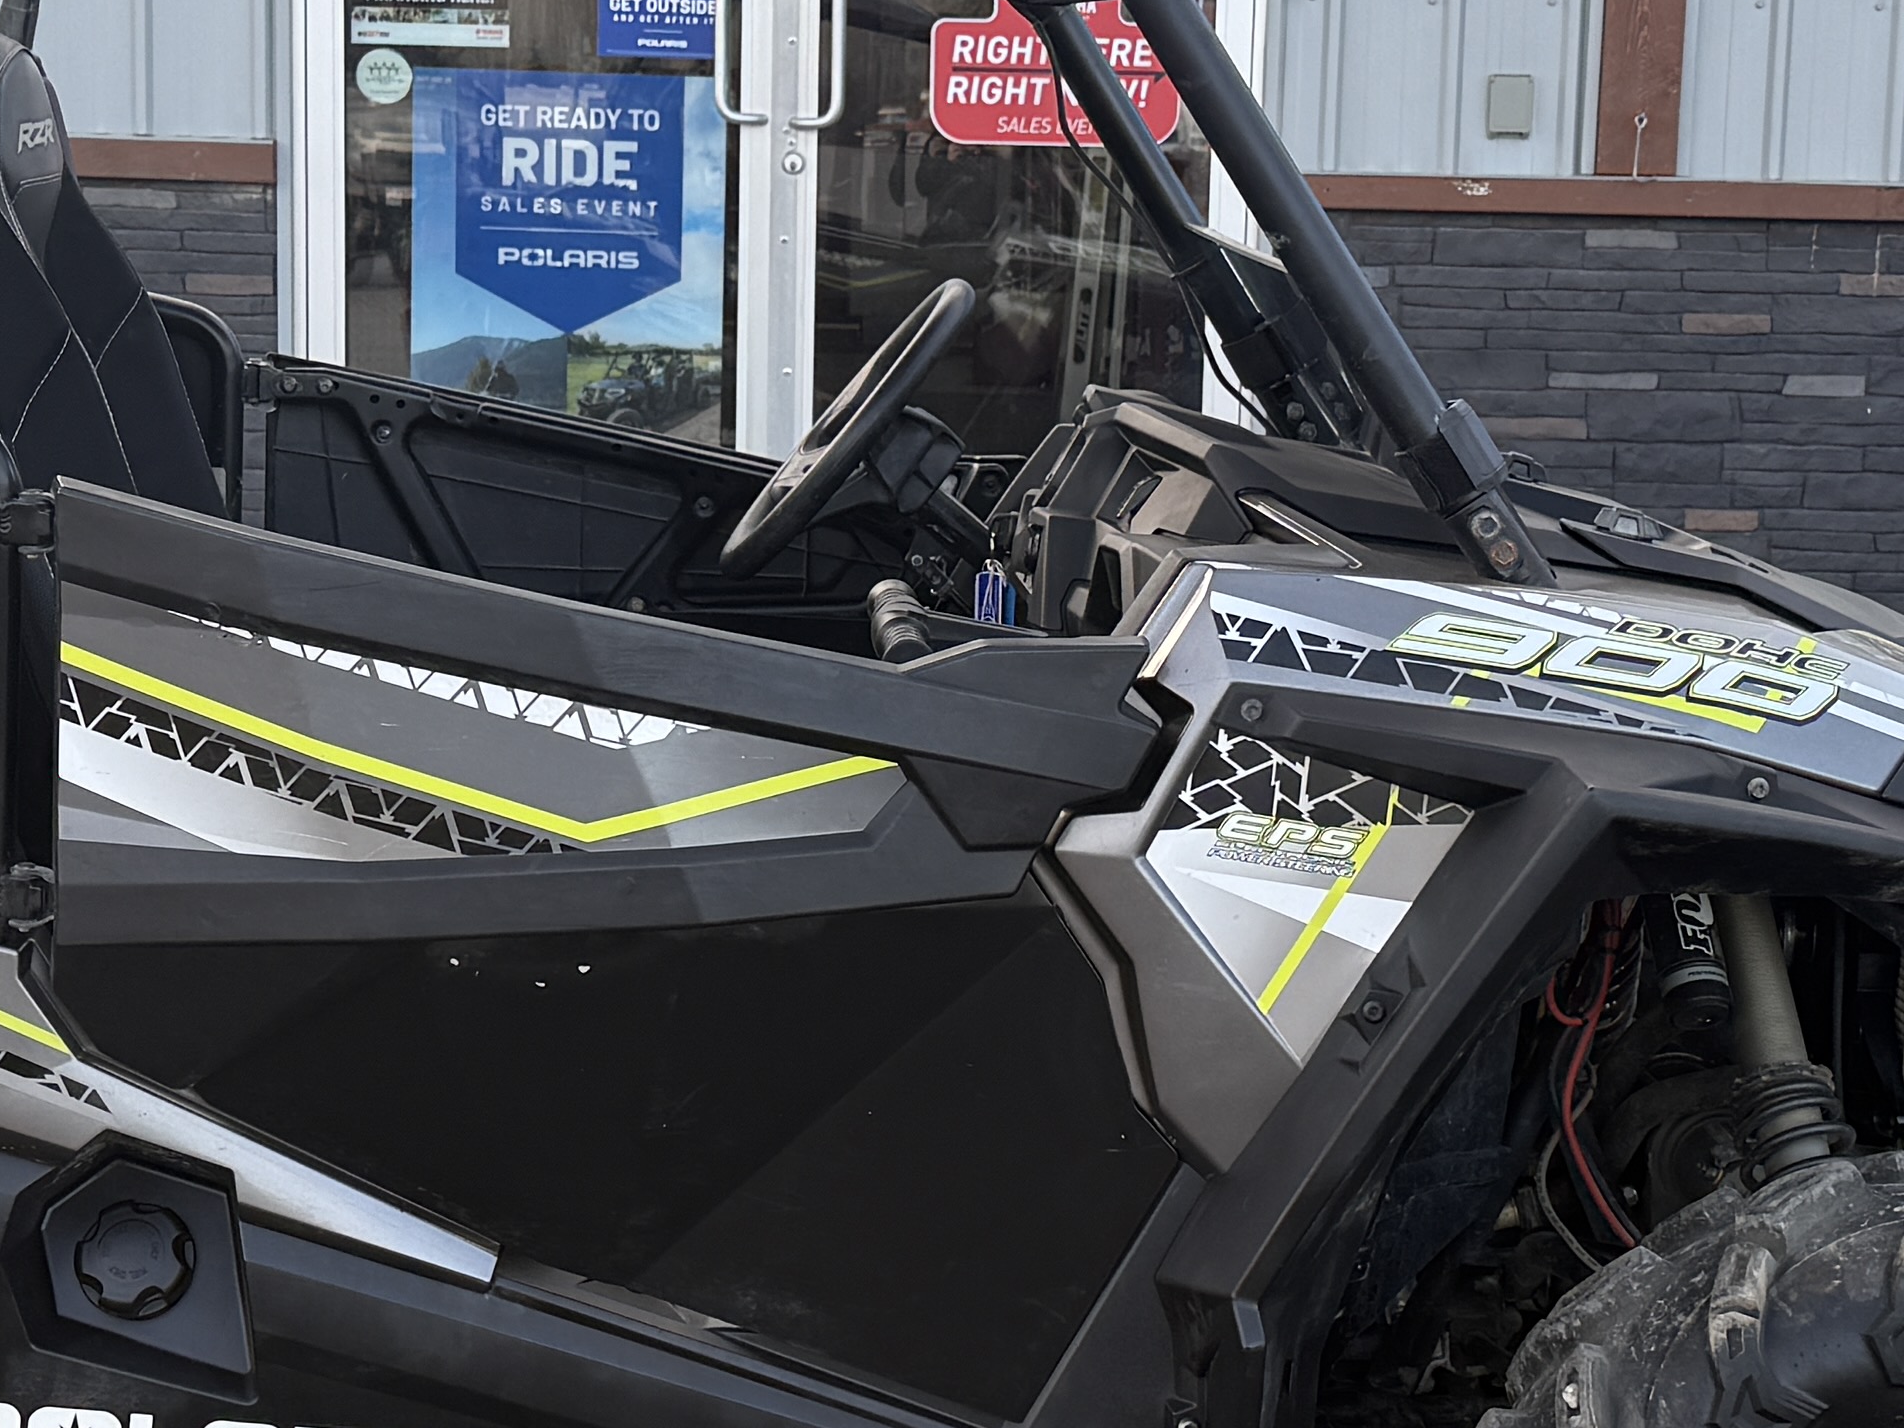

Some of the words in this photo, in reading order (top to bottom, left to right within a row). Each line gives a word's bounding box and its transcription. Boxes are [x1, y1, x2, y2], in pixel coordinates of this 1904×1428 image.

[1095, 38, 1153, 67] ERE
[946, 75, 1051, 106] RIGHT
[480, 104, 530, 127] GET
[535, 107, 621, 130] READY
[628, 108, 661, 131] TO
[997, 116, 1052, 134] SALES
[17, 118, 55, 154] RZR
[501, 137, 639, 190] RIDE
[480, 195, 563, 215] SALES
[577, 198, 659, 218] EVENT
[498, 248, 640, 269] POLARIS
[1608, 617, 1851, 680] DOHC
[1387, 612, 1840, 725] 900
[1215, 811, 1370, 860] EPS
